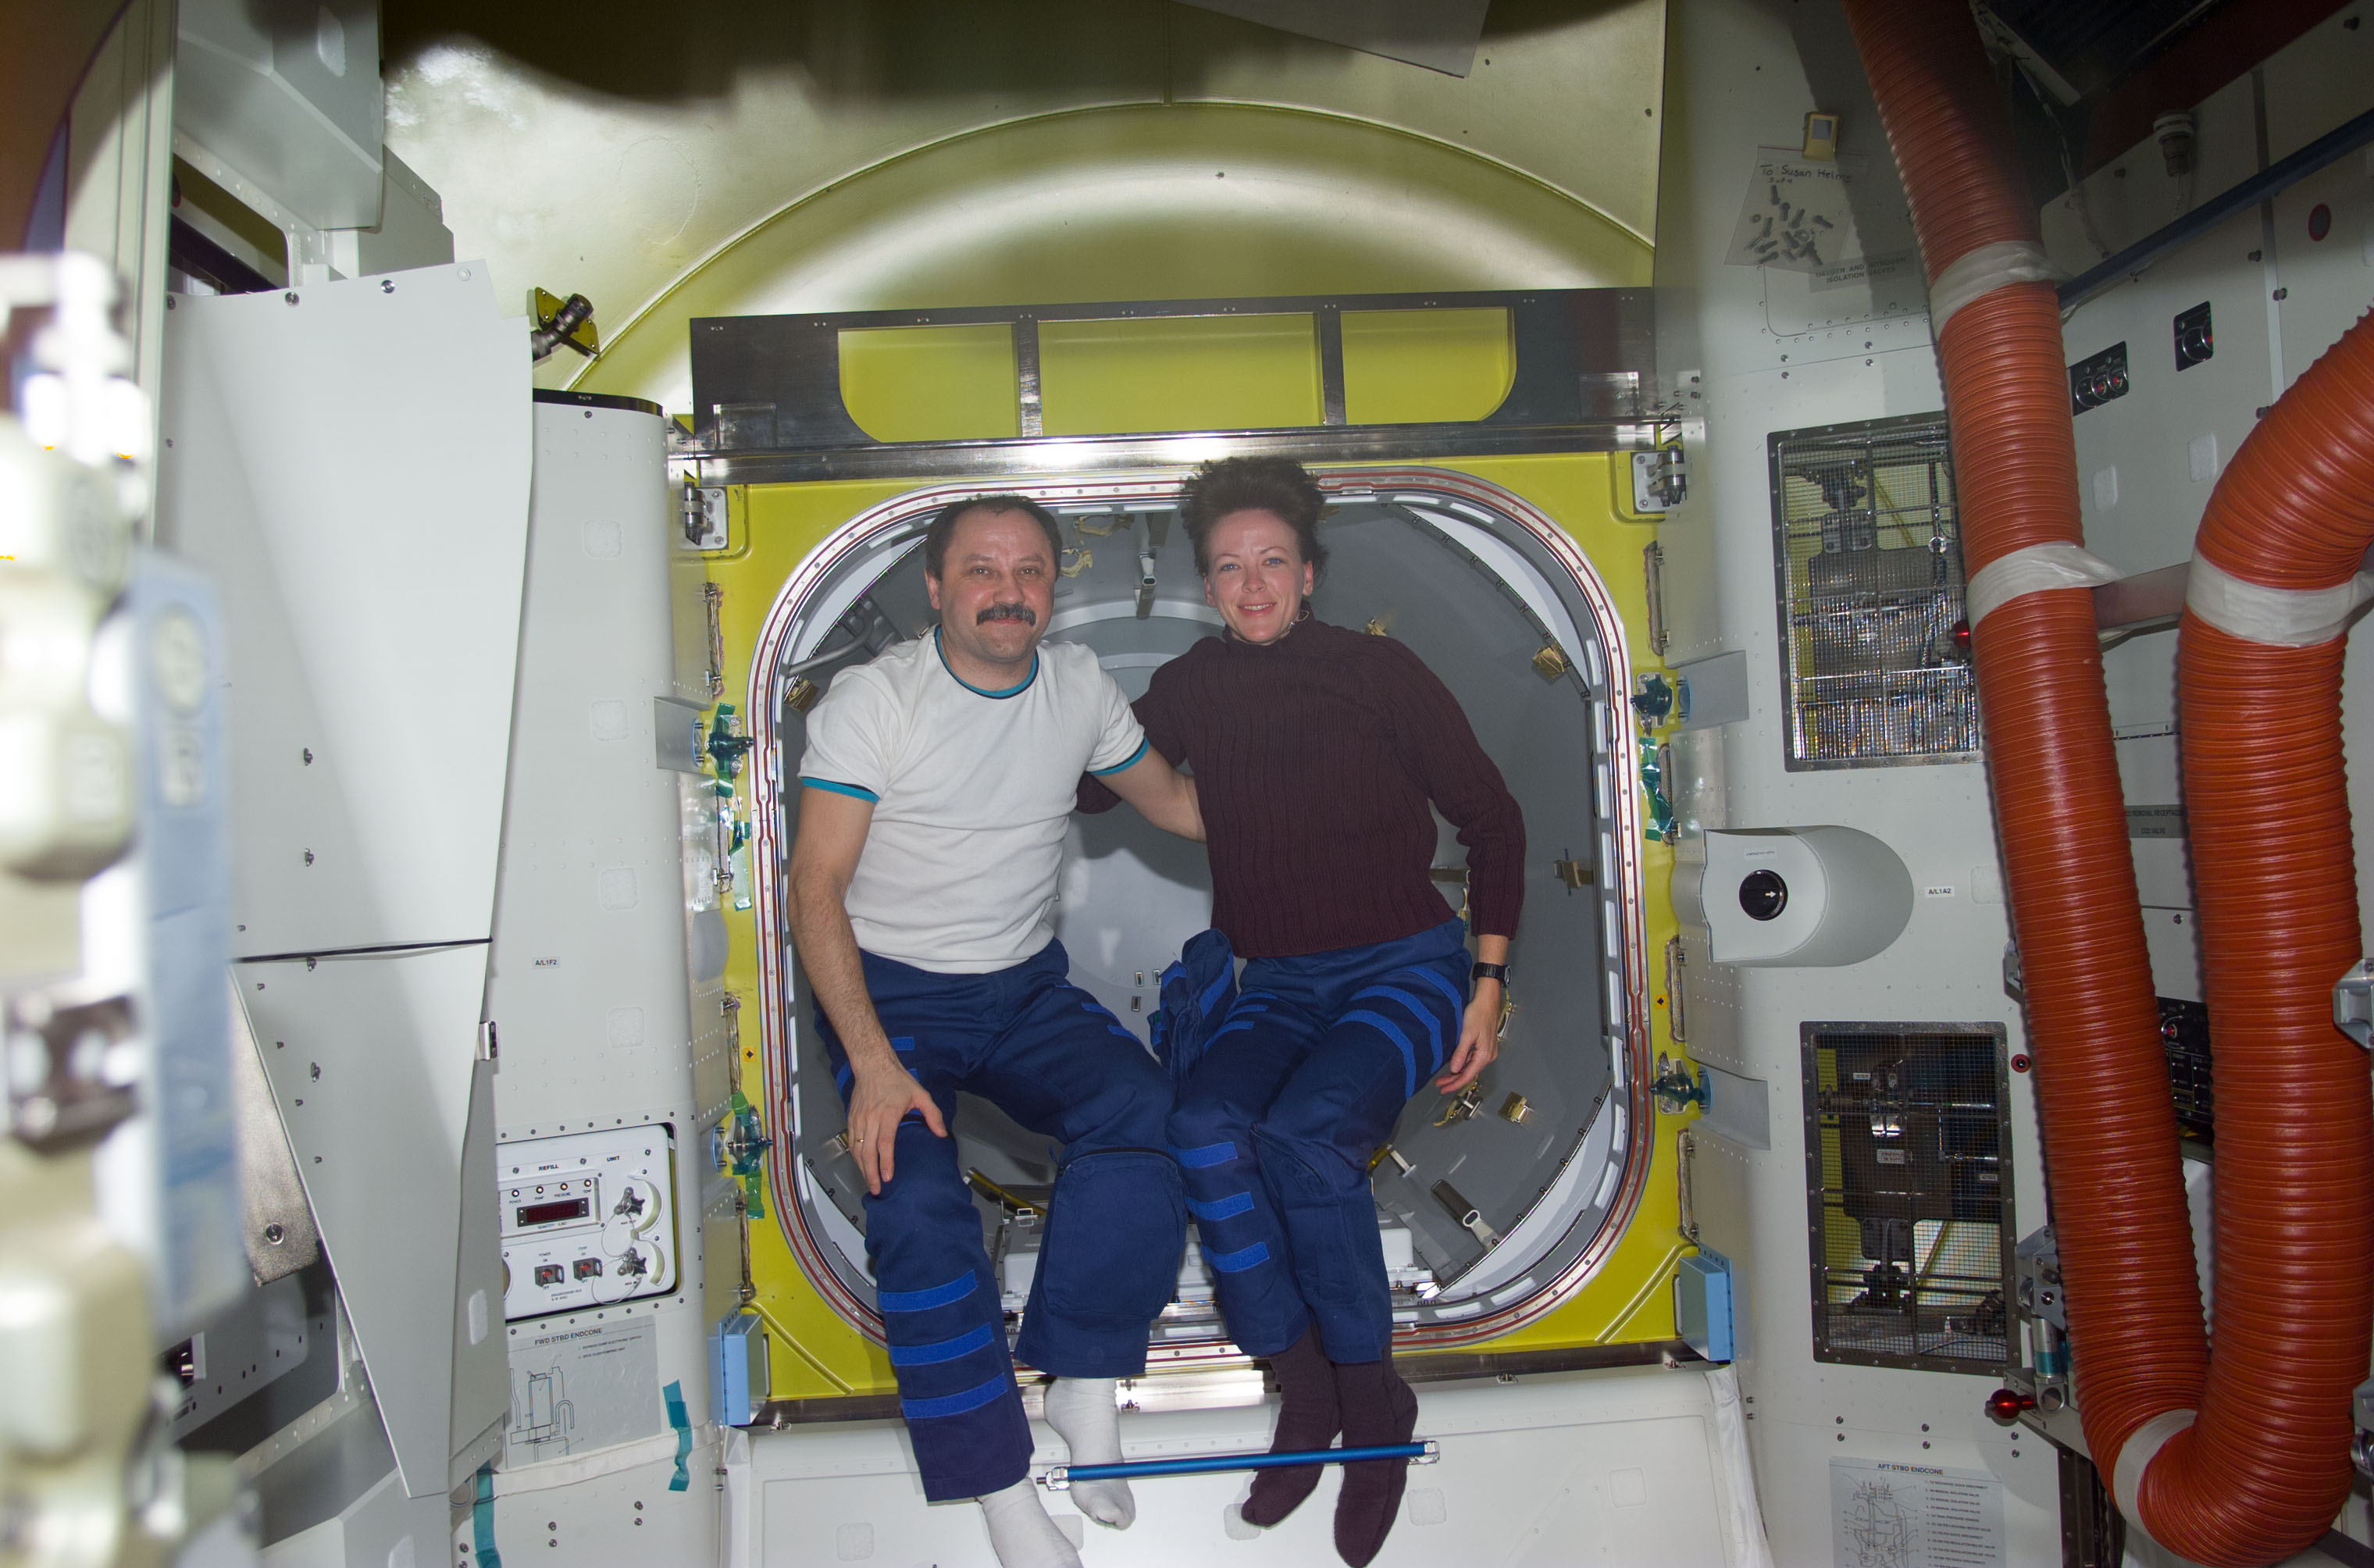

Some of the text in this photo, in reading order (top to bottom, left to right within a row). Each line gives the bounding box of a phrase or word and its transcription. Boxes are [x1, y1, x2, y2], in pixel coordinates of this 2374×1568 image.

[1781, 164, 1812, 177] Susan
[1826, 273, 1864, 283] ISOLATION
[551, 1334, 569, 1343] STBD
[570, 1327, 603, 1339] ENDCONE
[1910, 1466, 1944, 1475] ENDCONE
